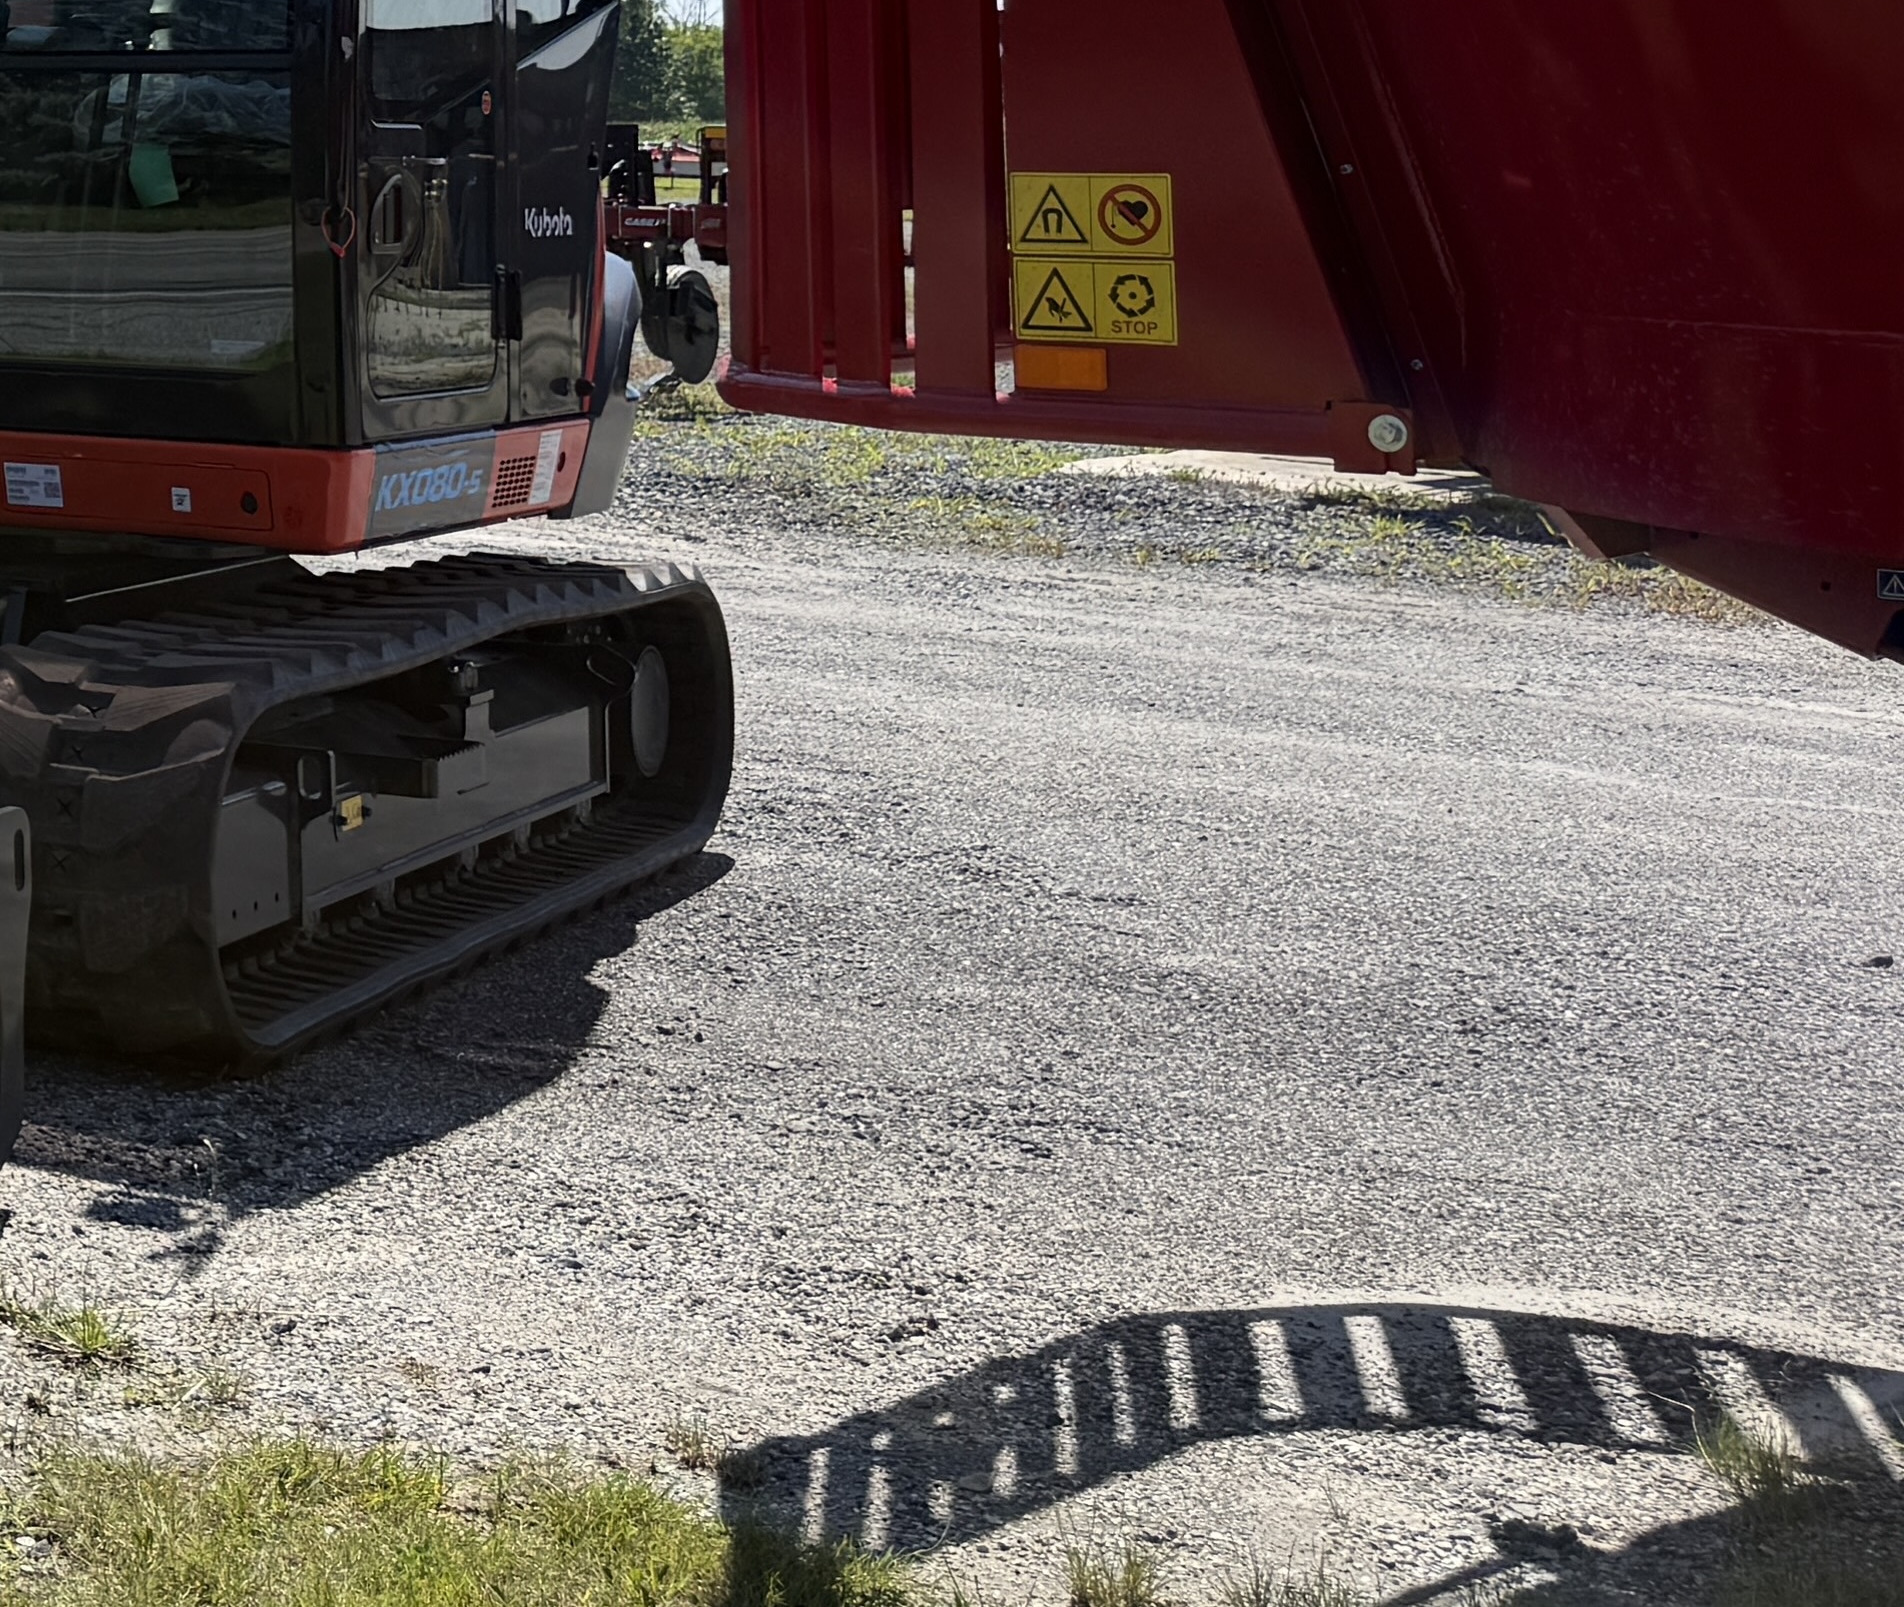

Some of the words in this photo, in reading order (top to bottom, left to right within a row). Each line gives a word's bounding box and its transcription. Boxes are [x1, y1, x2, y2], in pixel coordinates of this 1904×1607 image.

[524, 206, 573, 238] Kubota
[1111, 320, 1158, 335] STOP
[374, 461, 484, 513] KX080-5
